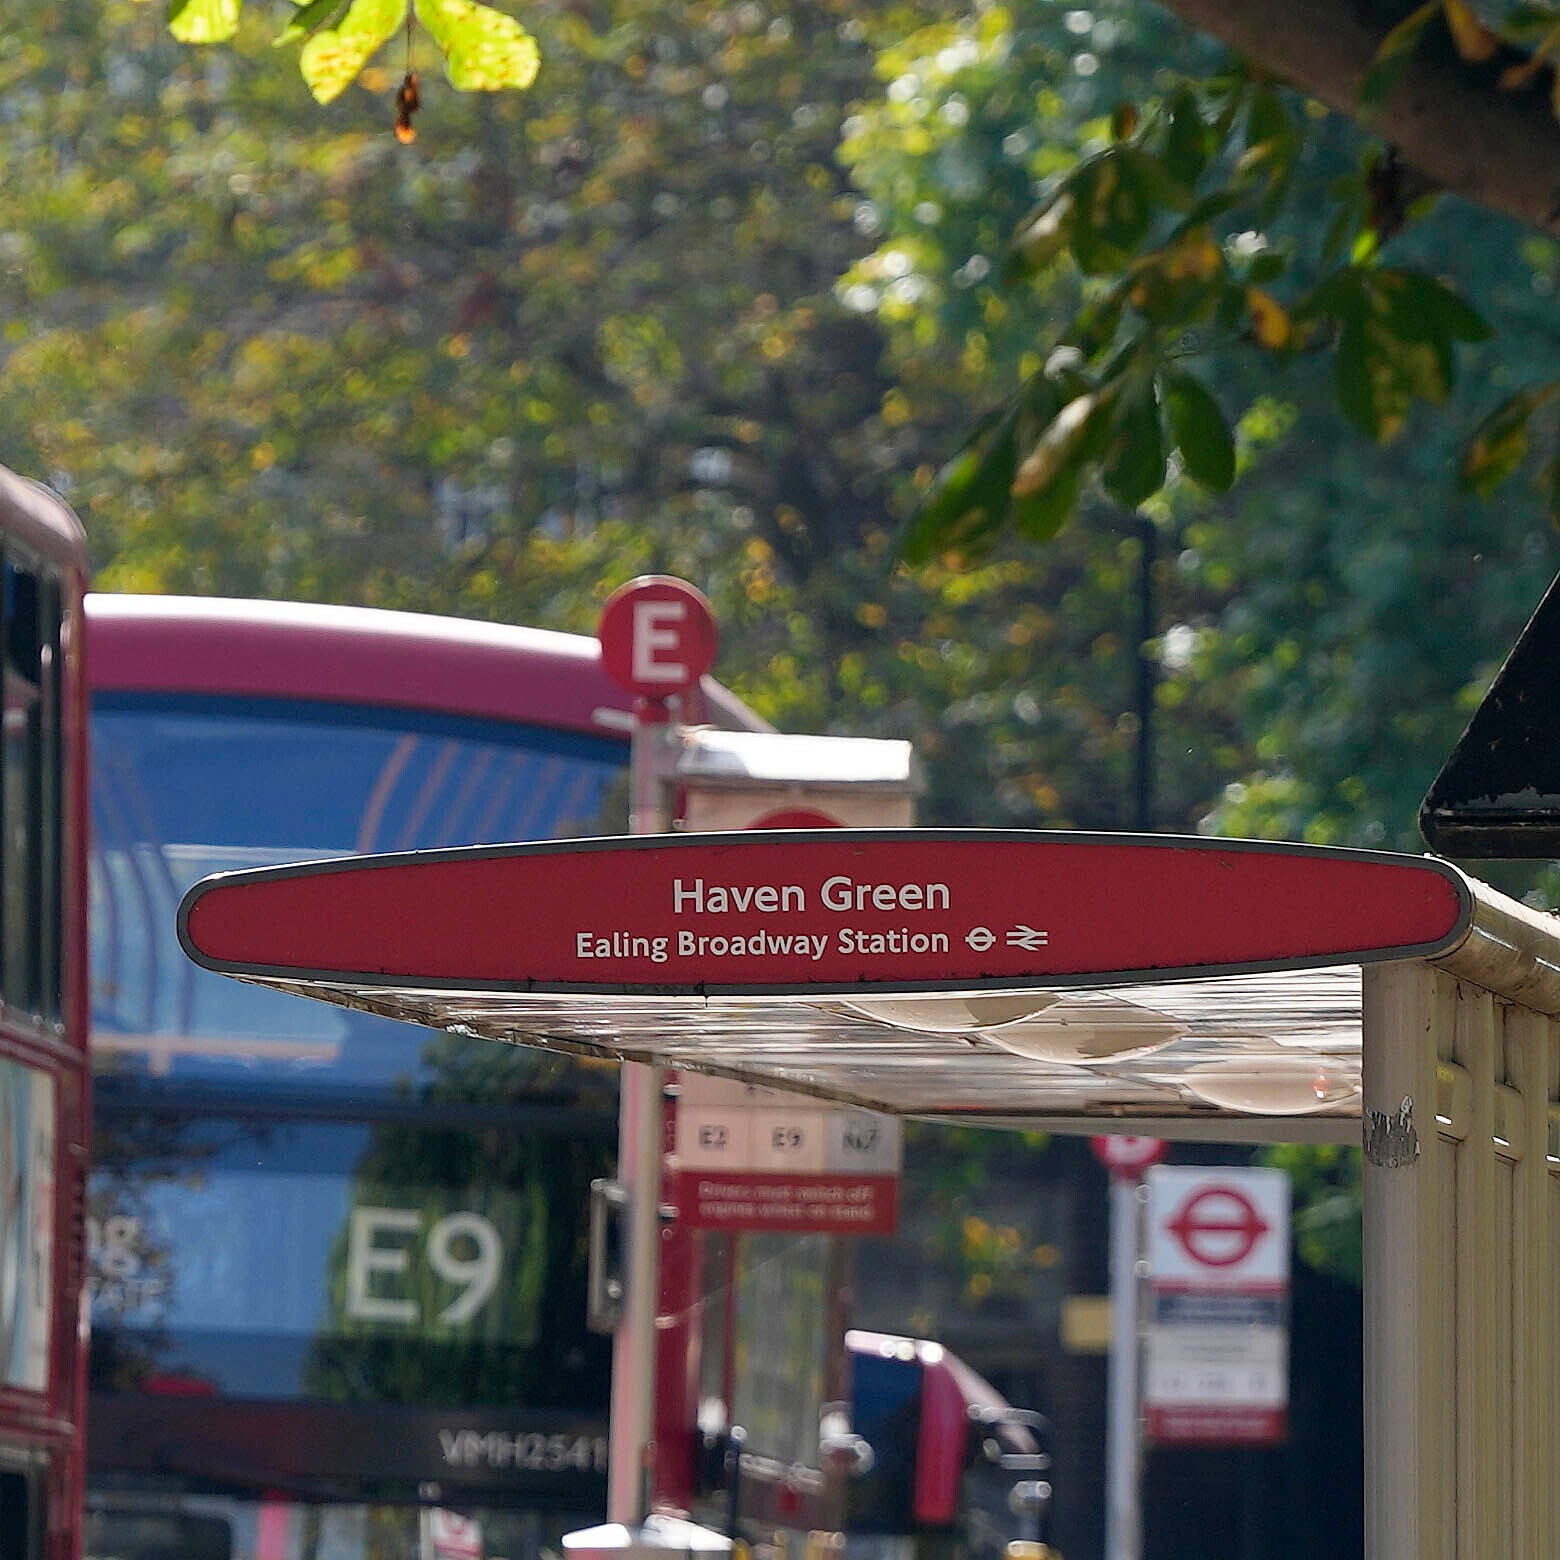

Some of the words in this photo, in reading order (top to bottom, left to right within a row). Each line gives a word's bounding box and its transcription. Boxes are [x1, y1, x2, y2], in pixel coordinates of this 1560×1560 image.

[631, 600, 689, 683] E
[671, 878, 806, 914] Haven
[820, 875, 951, 911] Green
[575, 931, 669, 964] Ealing
[678, 929, 829, 961] Broadway
[838, 927, 950, 954] Station
[344, 1203, 506, 1326] E9
